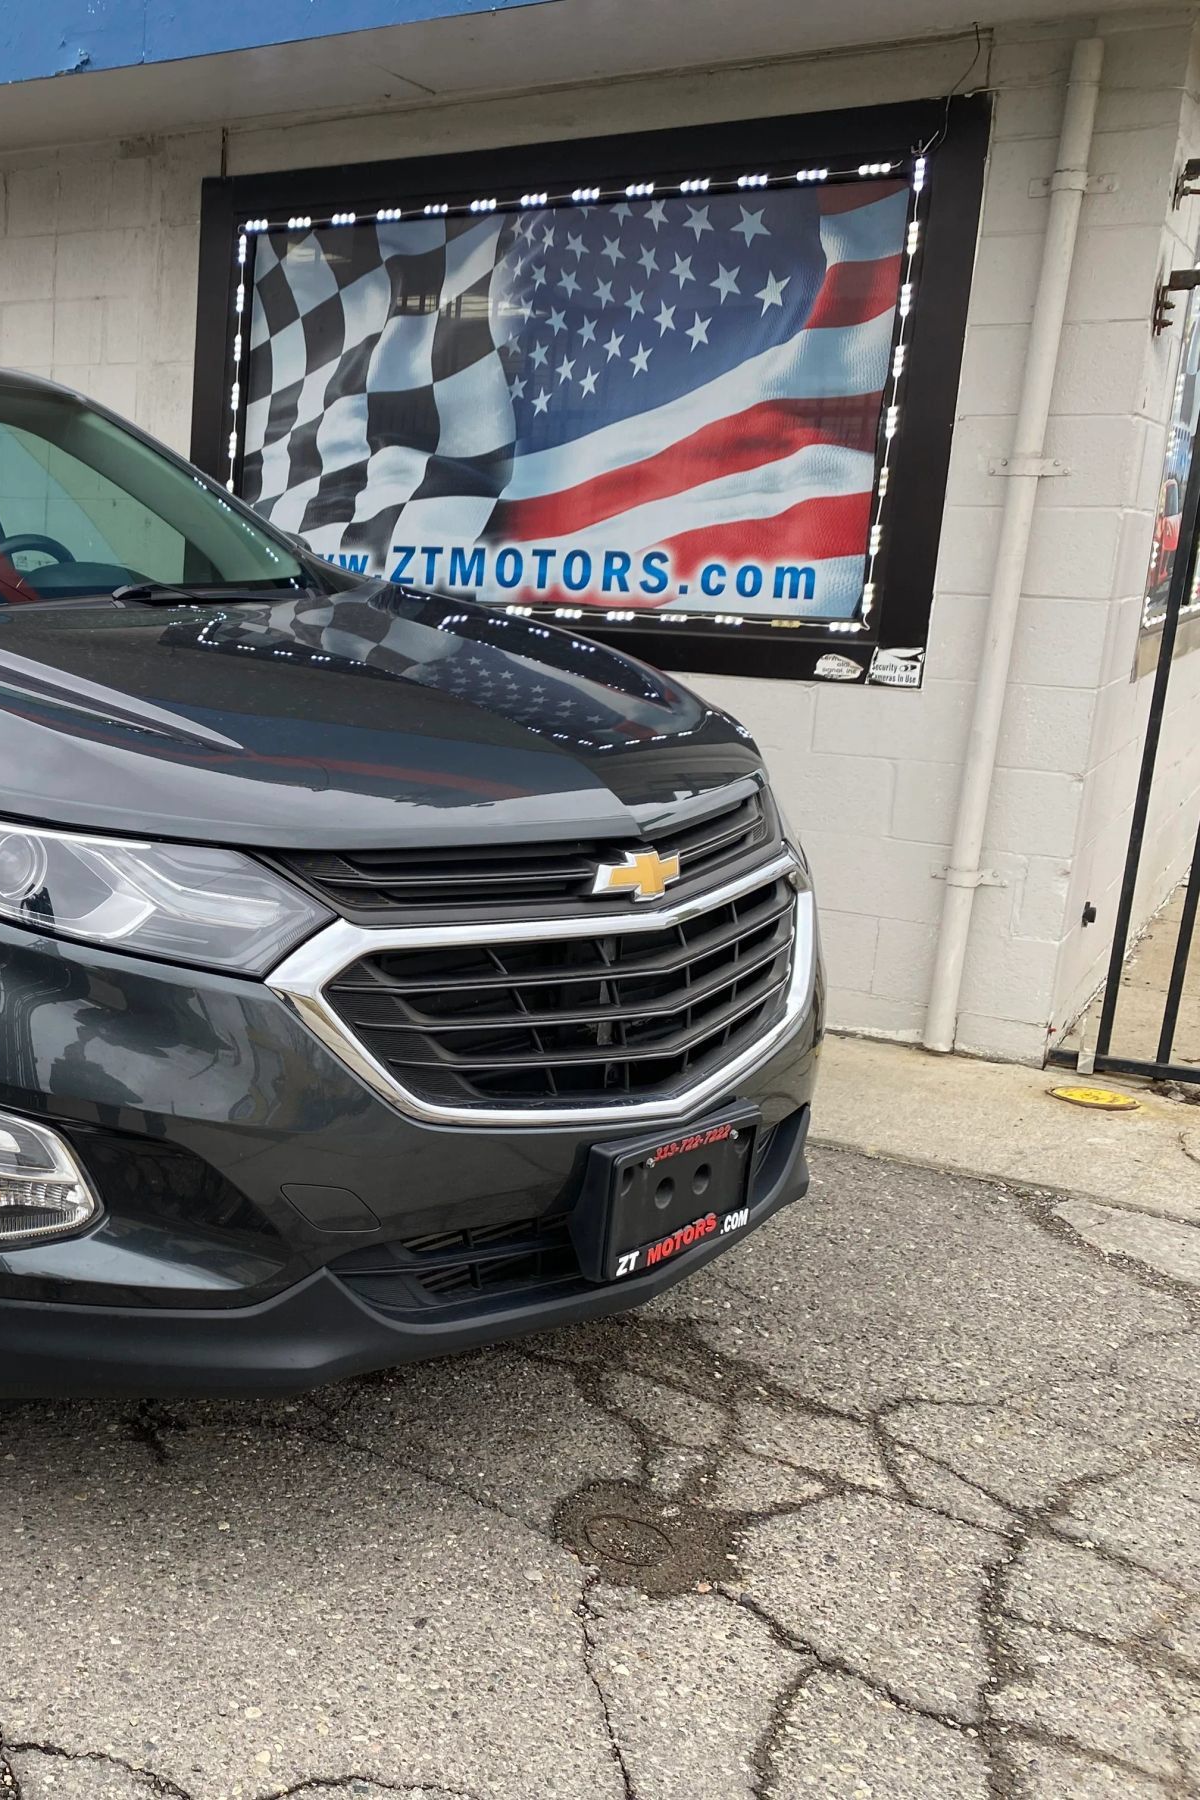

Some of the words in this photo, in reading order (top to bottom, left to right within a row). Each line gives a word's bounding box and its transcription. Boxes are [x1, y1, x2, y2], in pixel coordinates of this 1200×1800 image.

[317, 545, 817, 600] w.ZTMOTORS.com
[616, 1250, 640, 1277] ZT
[646, 1212, 717, 1267] MOTORS
[720, 1208, 749, 1234] .COM
